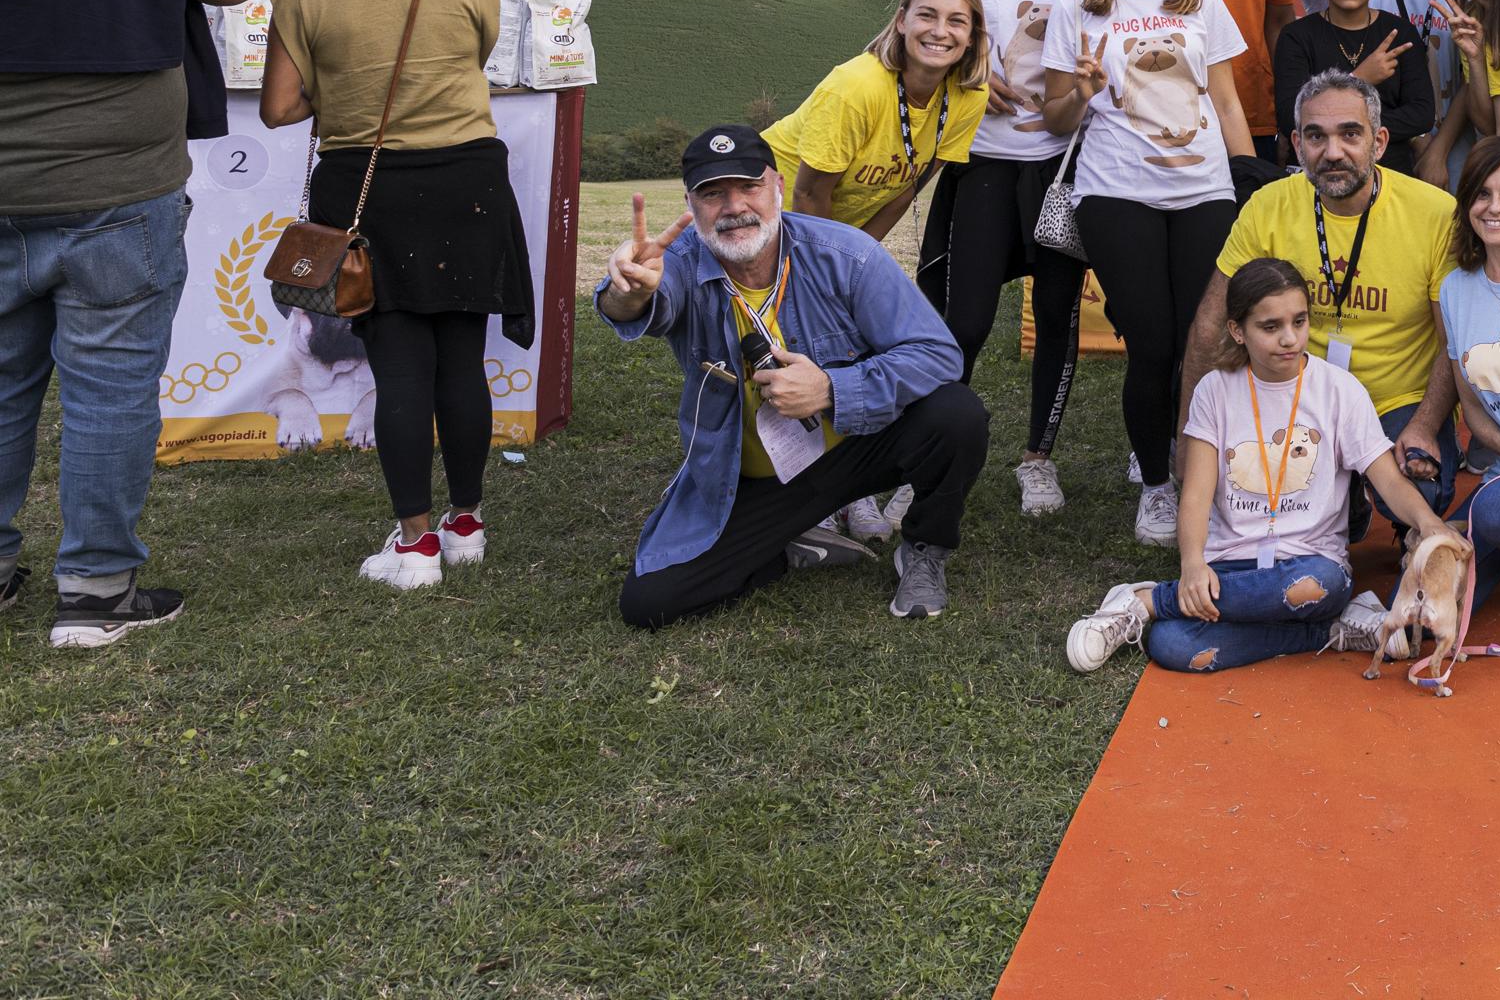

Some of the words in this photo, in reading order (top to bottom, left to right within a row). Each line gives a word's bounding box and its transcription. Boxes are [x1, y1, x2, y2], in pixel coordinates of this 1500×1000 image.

[1113, 18, 1140, 34] PUG
[1143, 15, 1187, 32] KARMA
[1410, 13, 1448, 31] KAMA
[549, 54, 565, 62] MINI
[229, 151, 249, 173] 2
[165, 429, 267, 449] www.ugopiadi.it
[1226, 493, 1260, 512] time
[1280, 498, 1311, 513] Relax
